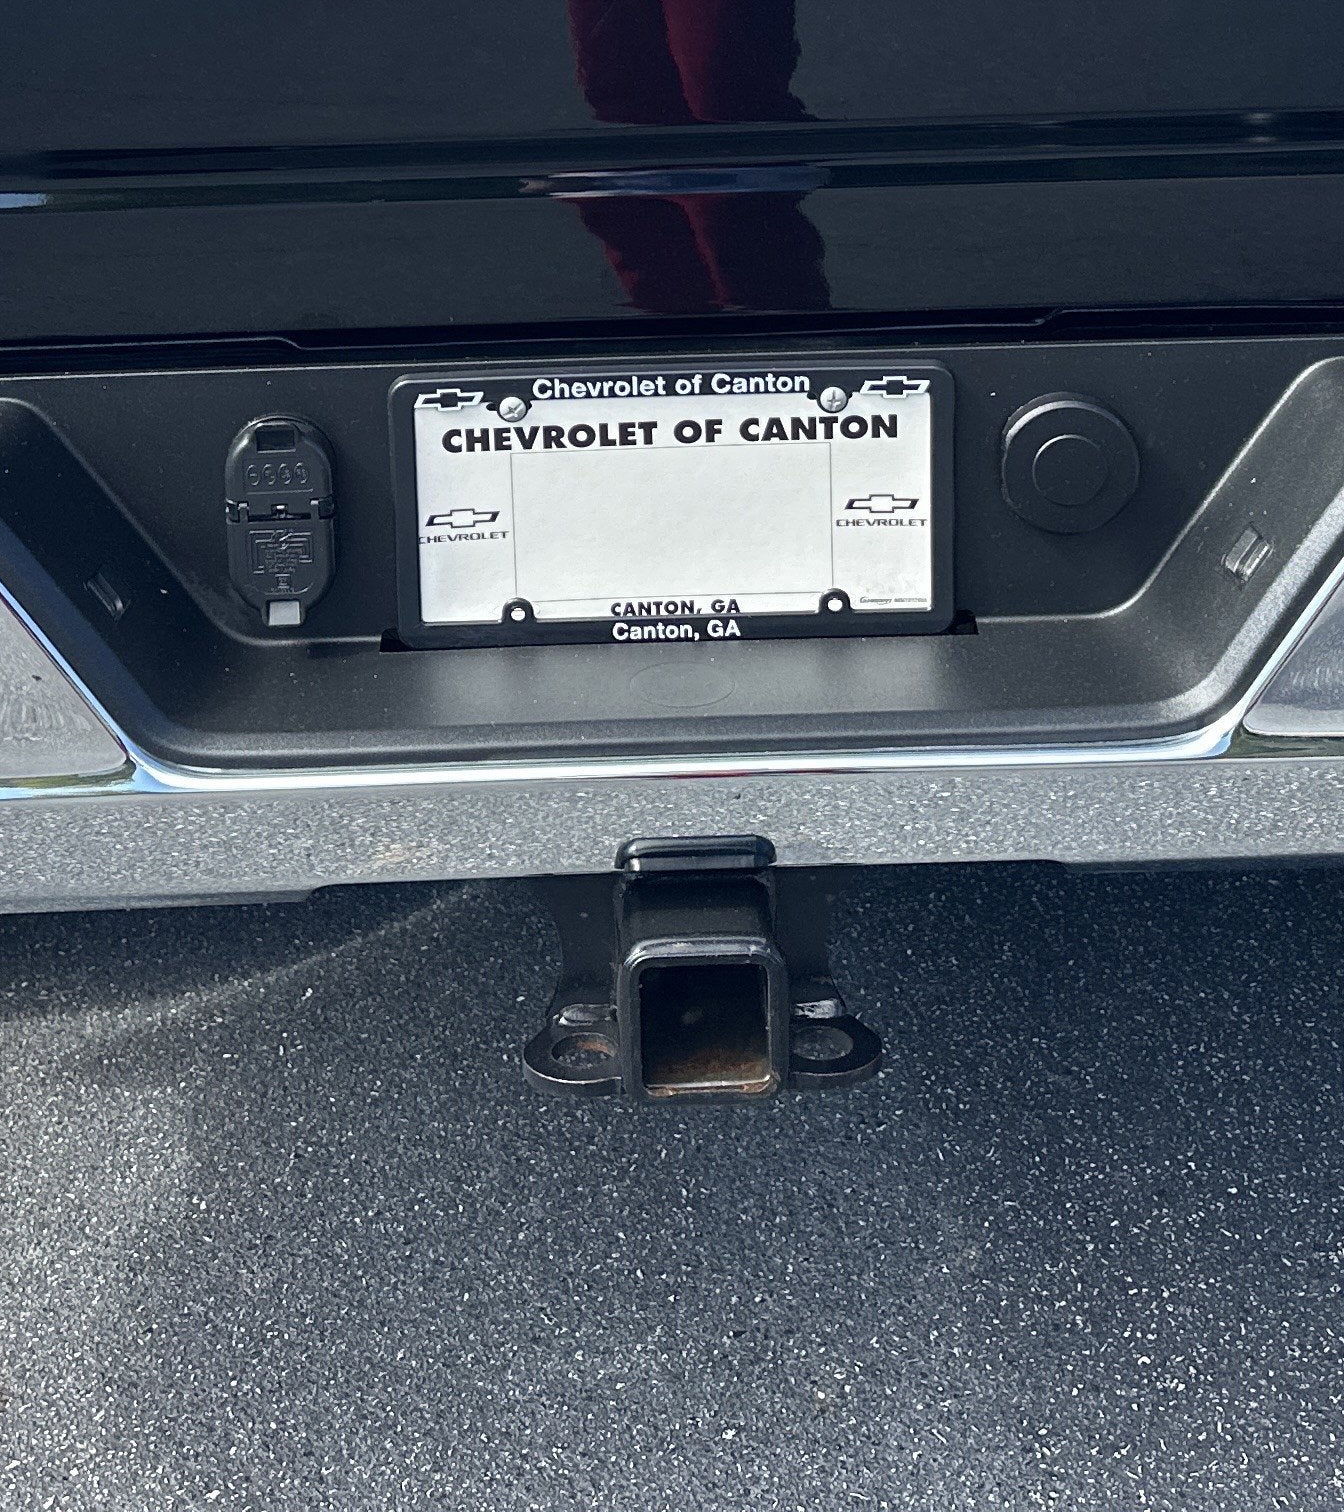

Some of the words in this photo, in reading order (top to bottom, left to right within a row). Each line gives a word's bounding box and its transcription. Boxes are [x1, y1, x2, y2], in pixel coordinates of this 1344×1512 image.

[532, 375, 666, 399] Chevrolet
[674, 373, 703, 396] of
[710, 372, 810, 394] Canton
[441, 420, 658, 454] CHEVROLET
[673, 418, 723, 444] OF
[739, 413, 898, 442] CANTON
[836, 518, 928, 527] CHEVROLET
[610, 600, 702, 616] CANTON,
[710, 598, 741, 614] GA
[612, 621, 700, 641] Canton,
[706, 619, 741, 638] GA
